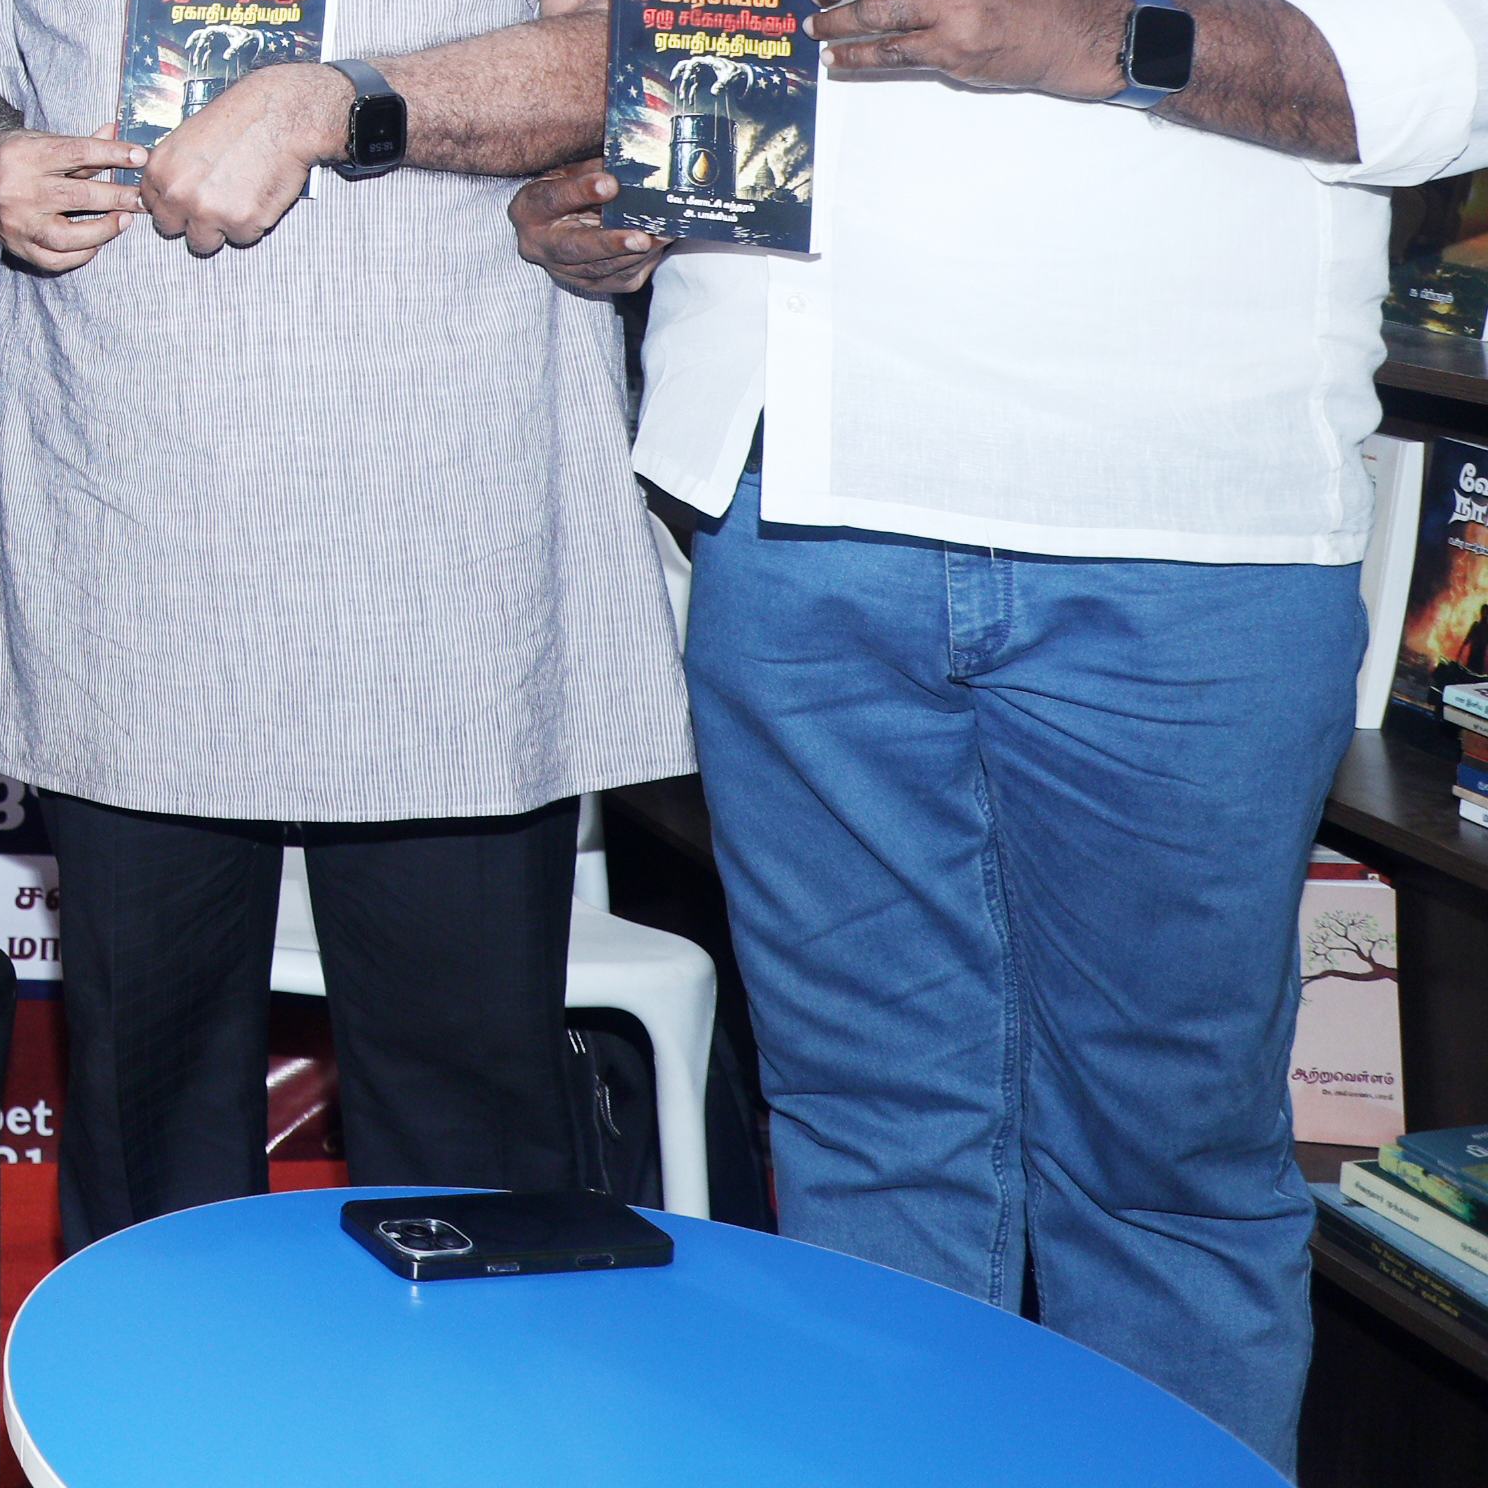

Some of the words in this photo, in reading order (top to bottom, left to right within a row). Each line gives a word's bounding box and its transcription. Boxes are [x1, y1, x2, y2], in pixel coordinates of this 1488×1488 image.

[171, 3, 301, 26] ஏகாதிபத்தியமும்
[642, 7, 675, 30] ஏழு
[654, 32, 792, 59] ஏகாதிபத்தியமும்
[1291, 1066, 1394, 1086] ஆற்றுவெள்ளம்
